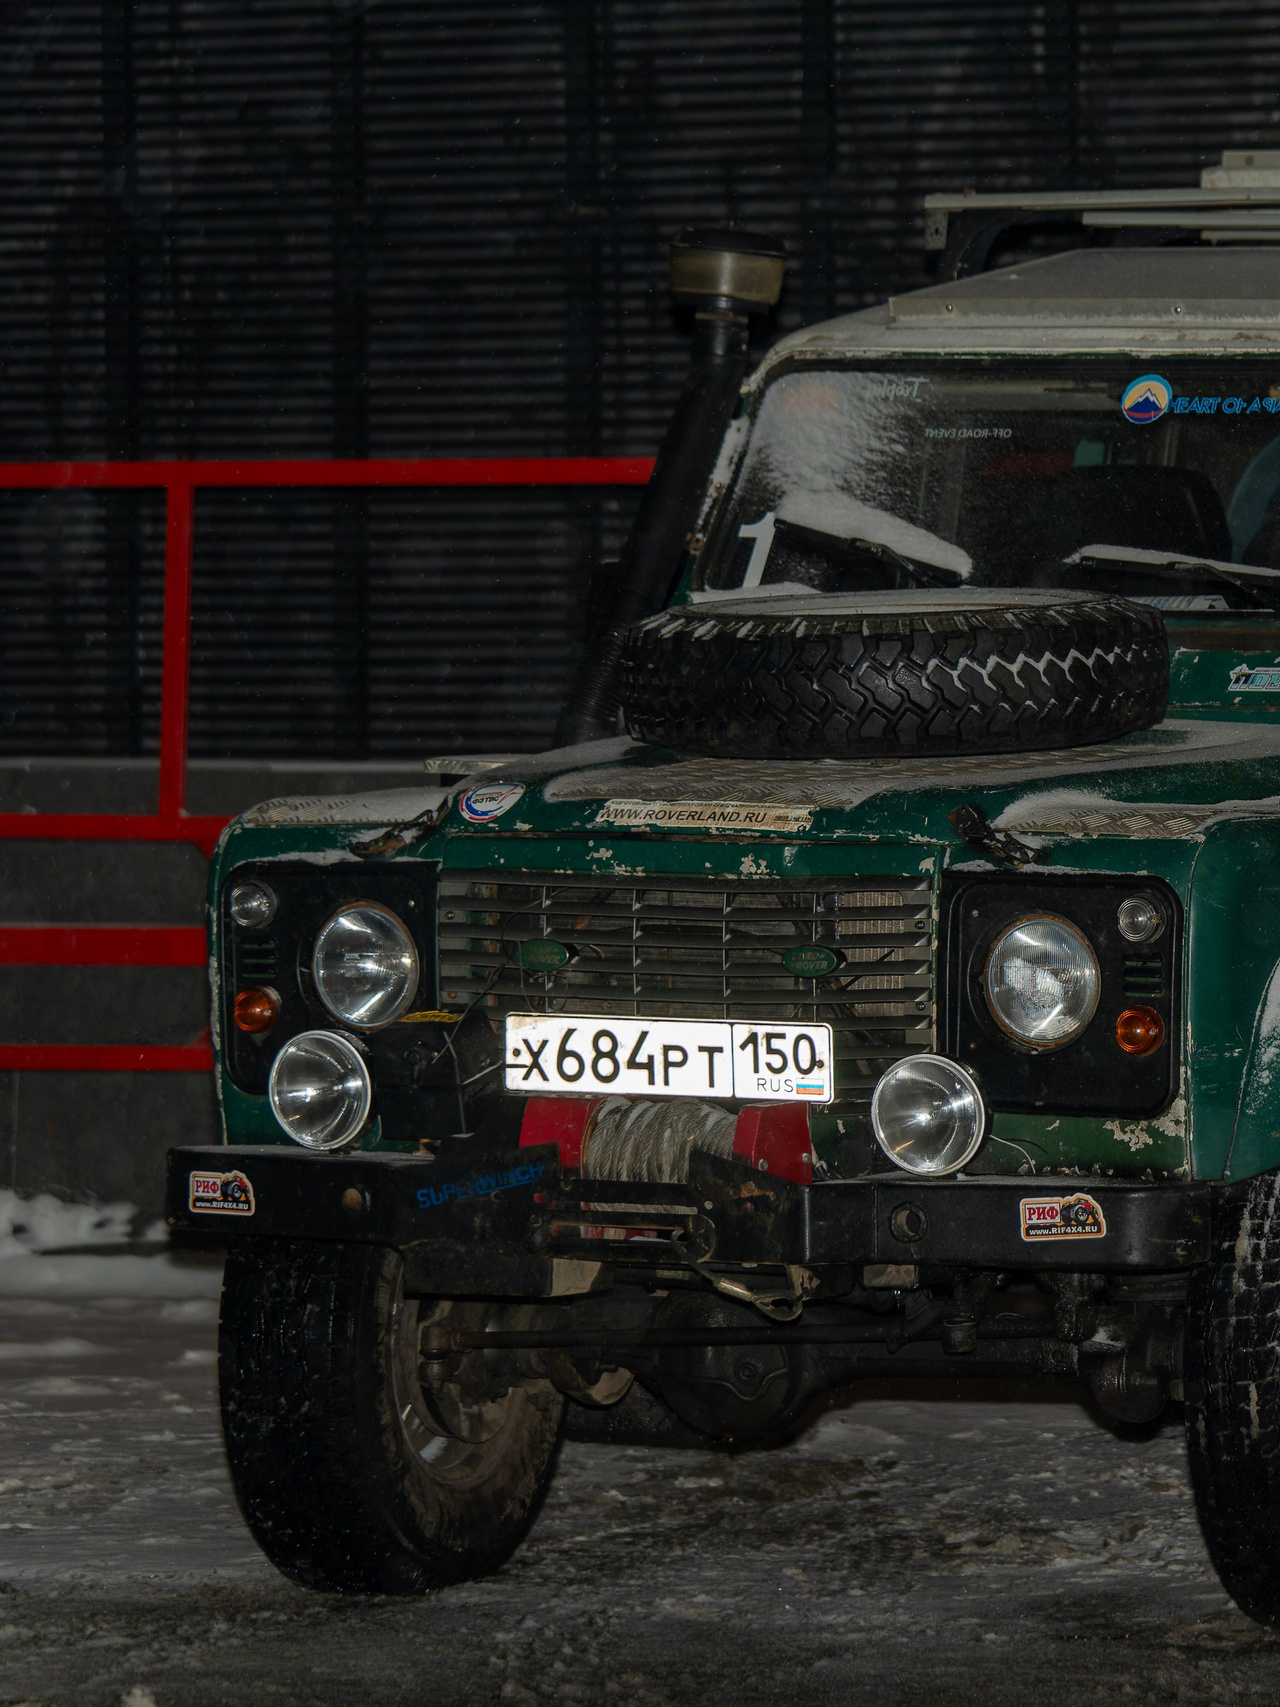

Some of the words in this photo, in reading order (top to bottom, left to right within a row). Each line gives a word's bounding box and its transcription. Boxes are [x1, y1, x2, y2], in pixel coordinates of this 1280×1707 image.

[601, 809, 766, 825] WWW.ROVERLAND.RU
[739, 1032, 817, 1076] 150
[757, 1078, 793, 1094] RUS
[194, 1180, 219, 1194] РИФ
[416, 1163, 544, 1209] SUPERWINCH
[1027, 1206, 1059, 1221] РИФ
